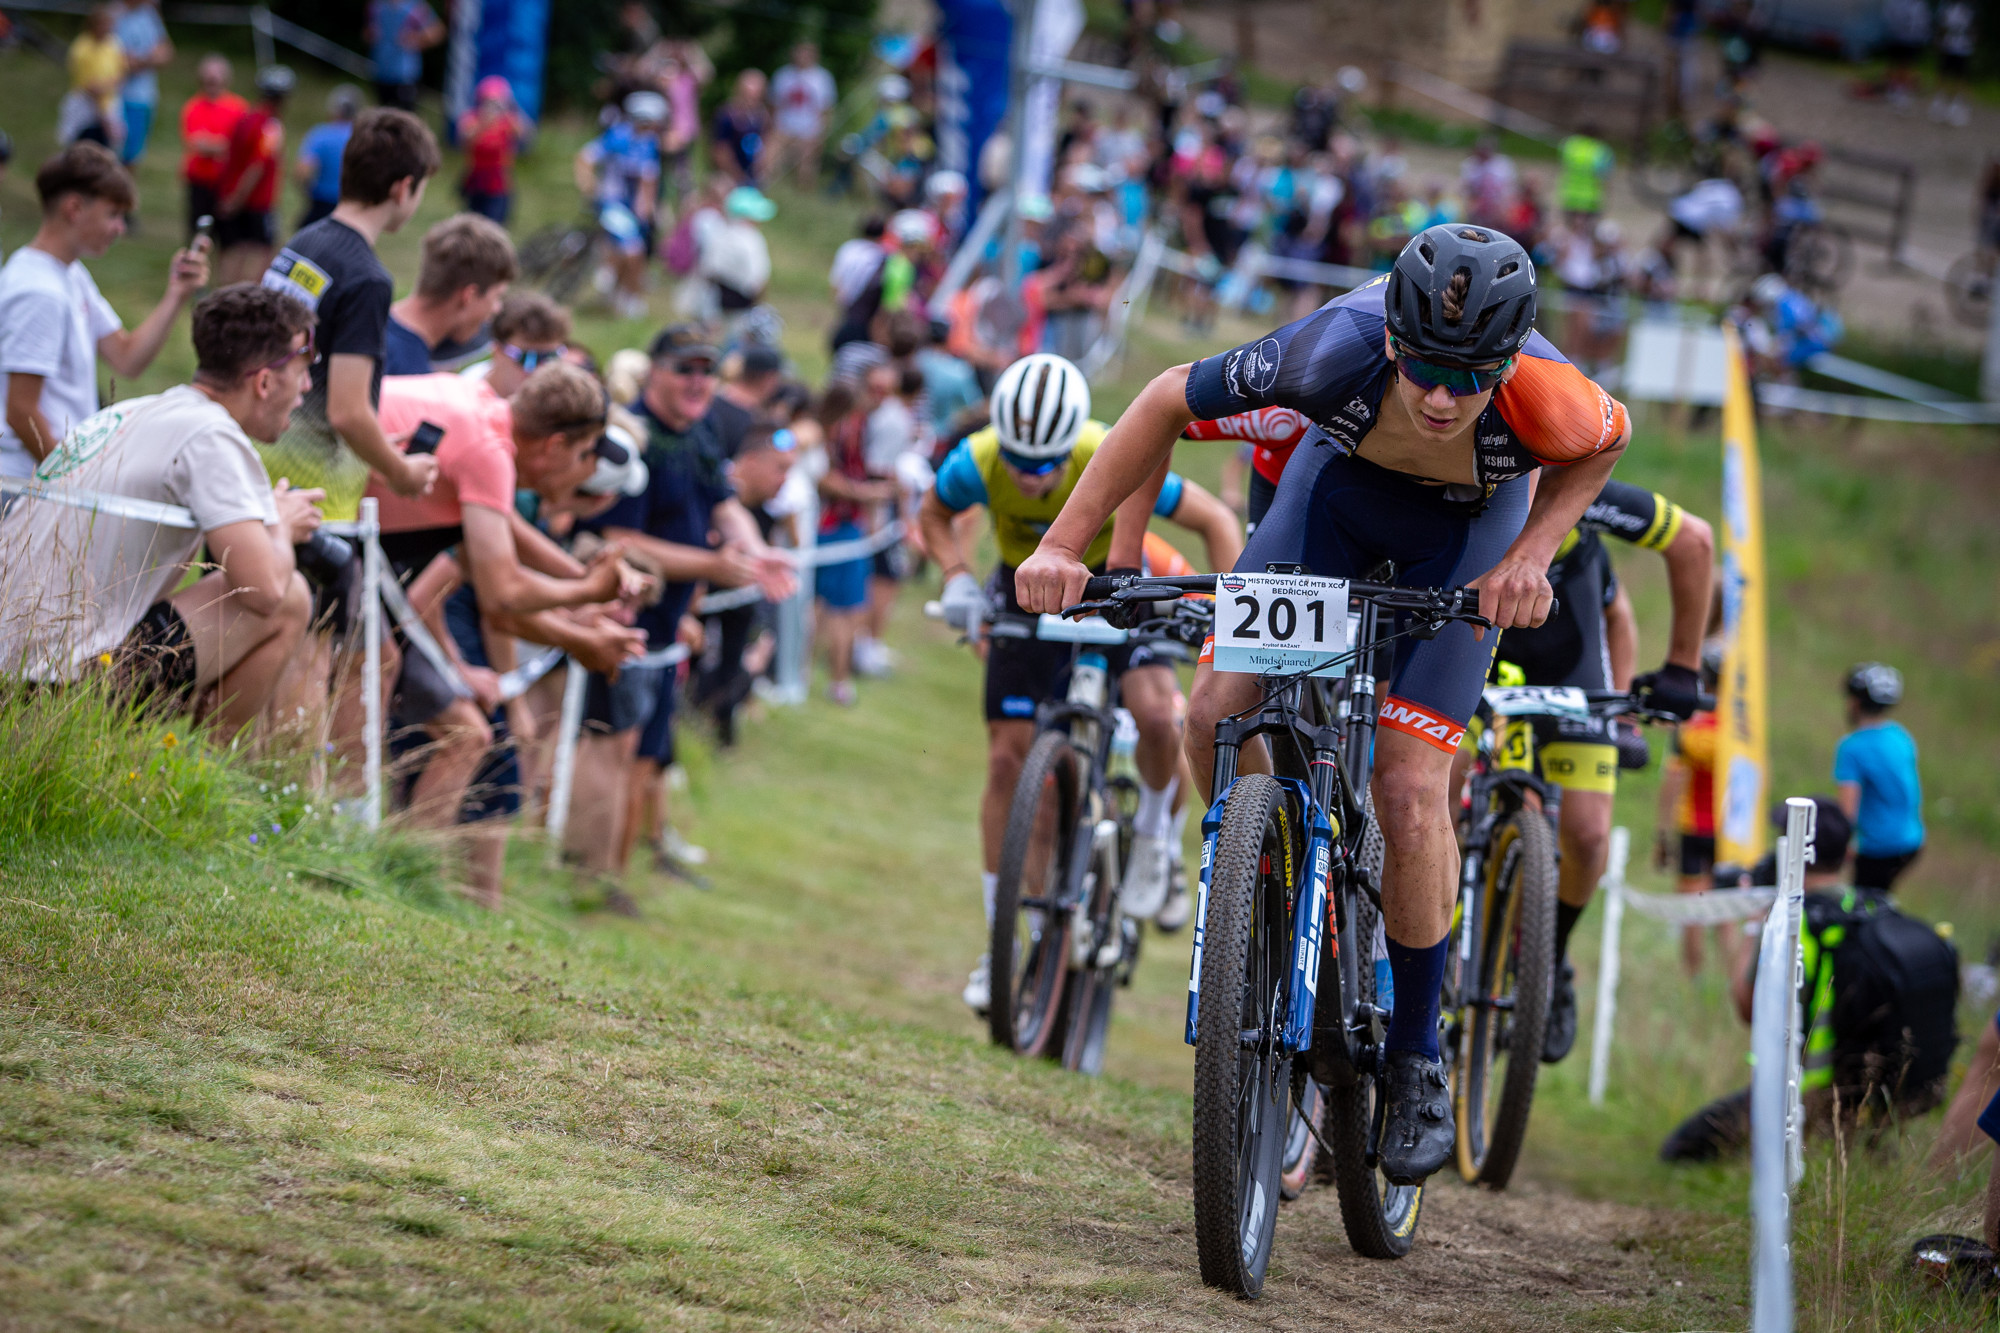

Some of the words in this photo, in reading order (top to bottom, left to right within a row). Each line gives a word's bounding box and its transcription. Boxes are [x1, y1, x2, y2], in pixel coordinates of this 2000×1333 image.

[1248, 577, 1297, 587] MISTROVSTVÍ
[1298, 578, 1309, 588] ČR
[1272, 587, 1319, 596] BEDŘICHOV
[1232, 595, 1325, 643] 201
[1379, 702, 1449, 741] ANTA
[1270, 848, 1281, 881] ZIPP
[1279, 810, 1293, 888] SCORPION
